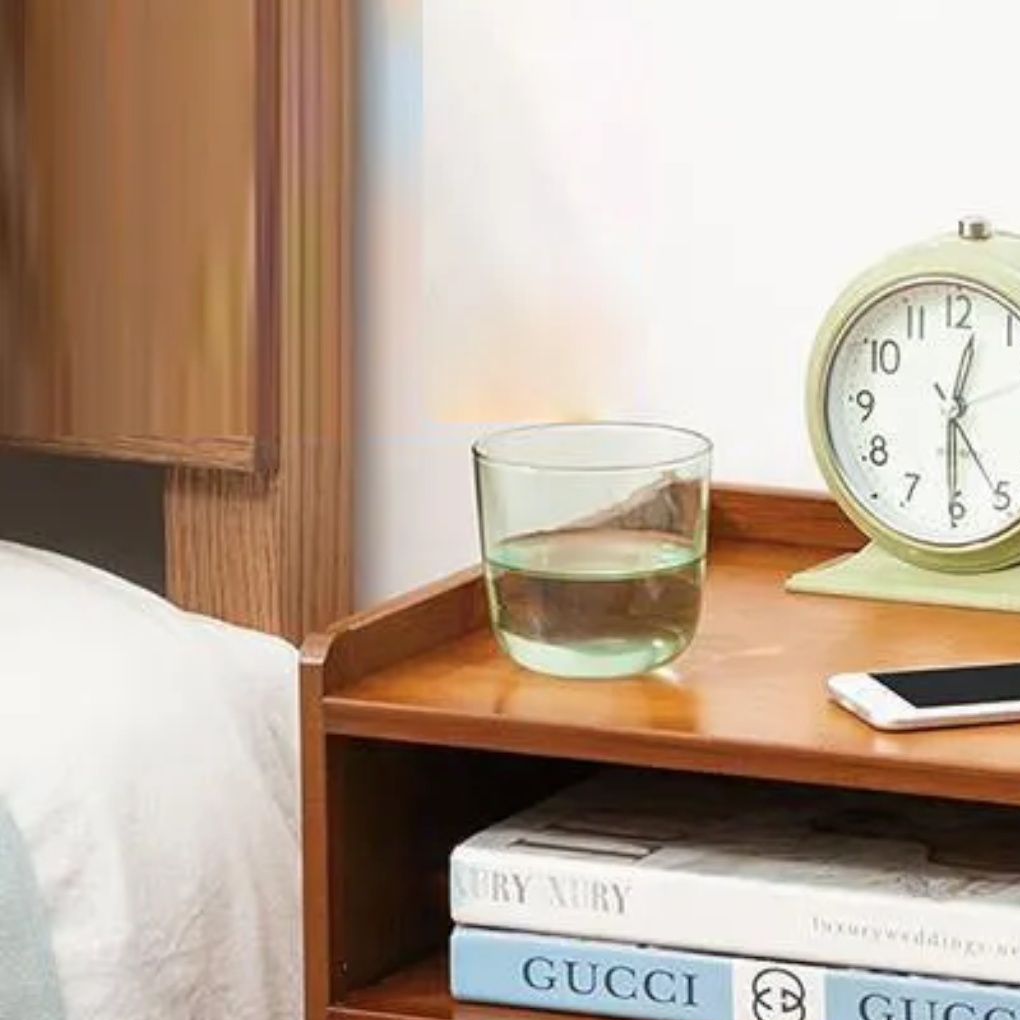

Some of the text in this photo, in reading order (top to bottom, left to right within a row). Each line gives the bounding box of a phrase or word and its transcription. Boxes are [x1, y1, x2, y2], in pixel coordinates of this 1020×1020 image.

[906, 305, 924, 340] 11
[945, 294, 973, 329] 12
[1006, 314, 1013, 347] 1
[871, 338, 900, 374] 10
[856, 389, 875, 422] 9
[869, 434, 888, 466] 8
[904, 473, 921, 501] 7
[992, 481, 1010, 511] 5
[948, 490, 966, 520] 6
[521, 956, 699, 1007] GUCCI
